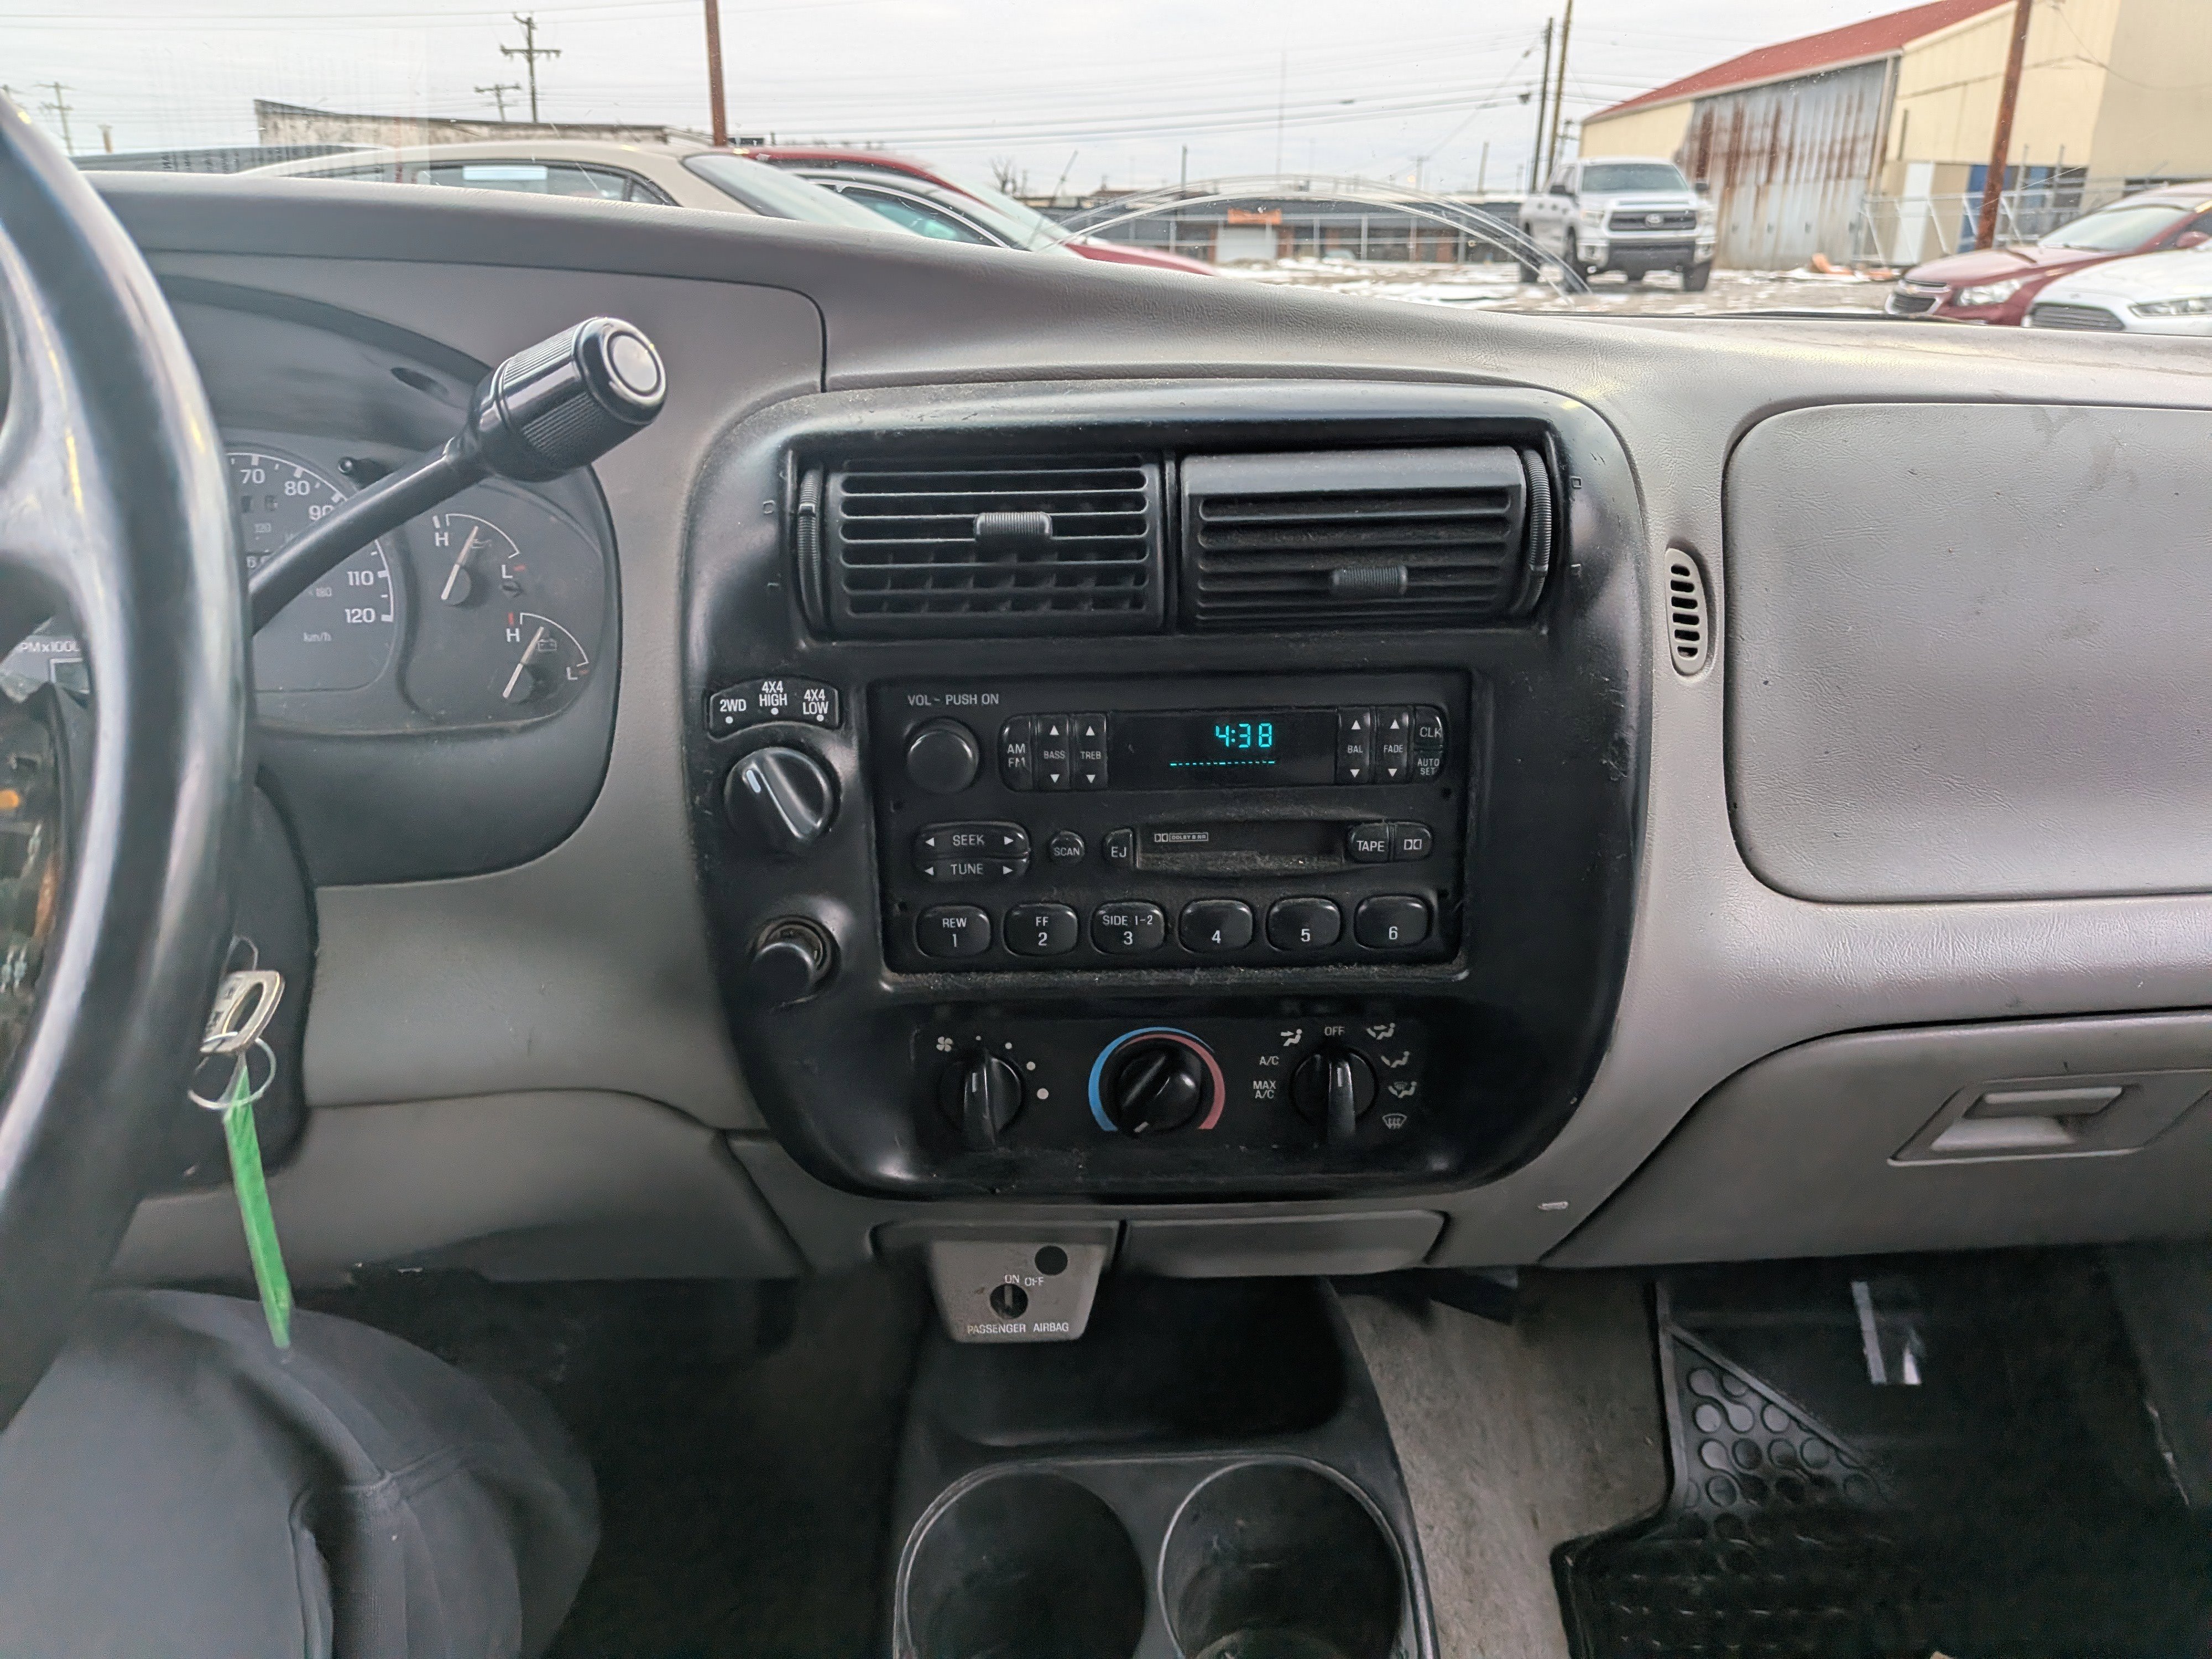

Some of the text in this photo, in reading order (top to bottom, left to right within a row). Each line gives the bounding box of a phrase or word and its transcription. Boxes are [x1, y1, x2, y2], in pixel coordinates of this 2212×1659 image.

[240, 469, 265, 483] 70
[285, 481, 310, 495] 80
[435, 532, 449, 546] H
[501, 565, 513, 578] L
[347, 571, 374, 586] 110
[345, 608, 376, 623] 120
[506, 628, 520, 643] H
[566, 667, 578, 680] L
[761, 680, 784, 693] 4X4
[759, 693, 787, 707] HIGH
[804, 688, 826, 702] 4X4
[946, 693, 978, 706] PUSH
[982, 693, 999, 705] ON
[719, 699, 747, 712] 2WD
[802, 701, 829, 714] LOW
[1215, 723, 1272, 748] 4:38
[1420, 727, 1442, 738] CLK
[1006, 743, 1026, 754] AM
[1044, 750, 1066, 759] BASS
[1347, 745, 1363, 754] BAL
[1384, 744, 1404, 753] FADE
[1080, 750, 1102, 760] TREB
[1008, 758, 1026, 768] FM
[1417, 758, 1440, 767] AUTO
[1420, 767, 1436, 776] SET
[952, 834, 985, 847] SEEK
[1357, 840, 1385, 852] TAPE
[1053, 846, 1080, 856] SCAN
[1111, 846, 1127, 858] EJ
[950, 863, 984, 875] TUNE
[942, 917, 967, 928] REW
[1036, 916, 1049, 927] FF
[1103, 915, 1129, 926] SIDE
[1123, 931, 1133, 945] 3
[1211, 930, 1222, 944] 4
[1301, 928, 1311, 942] 5
[1389, 926, 1399, 940] 6
[952, 934, 958, 948] 1
[1038, 932, 1048, 947] 2
[1324, 1026, 1345, 1036] OFF
[1259, 1056, 1280, 1066] A/C
[1253, 1080, 1276, 1090] MAX
[1255, 1089, 1275, 1099] A/C
[1004, 1274, 1020, 1284] ON
[1024, 1276, 1045, 1287] OFF
[968, 1322, 1070, 1334] PASSENGER AIRBAG
